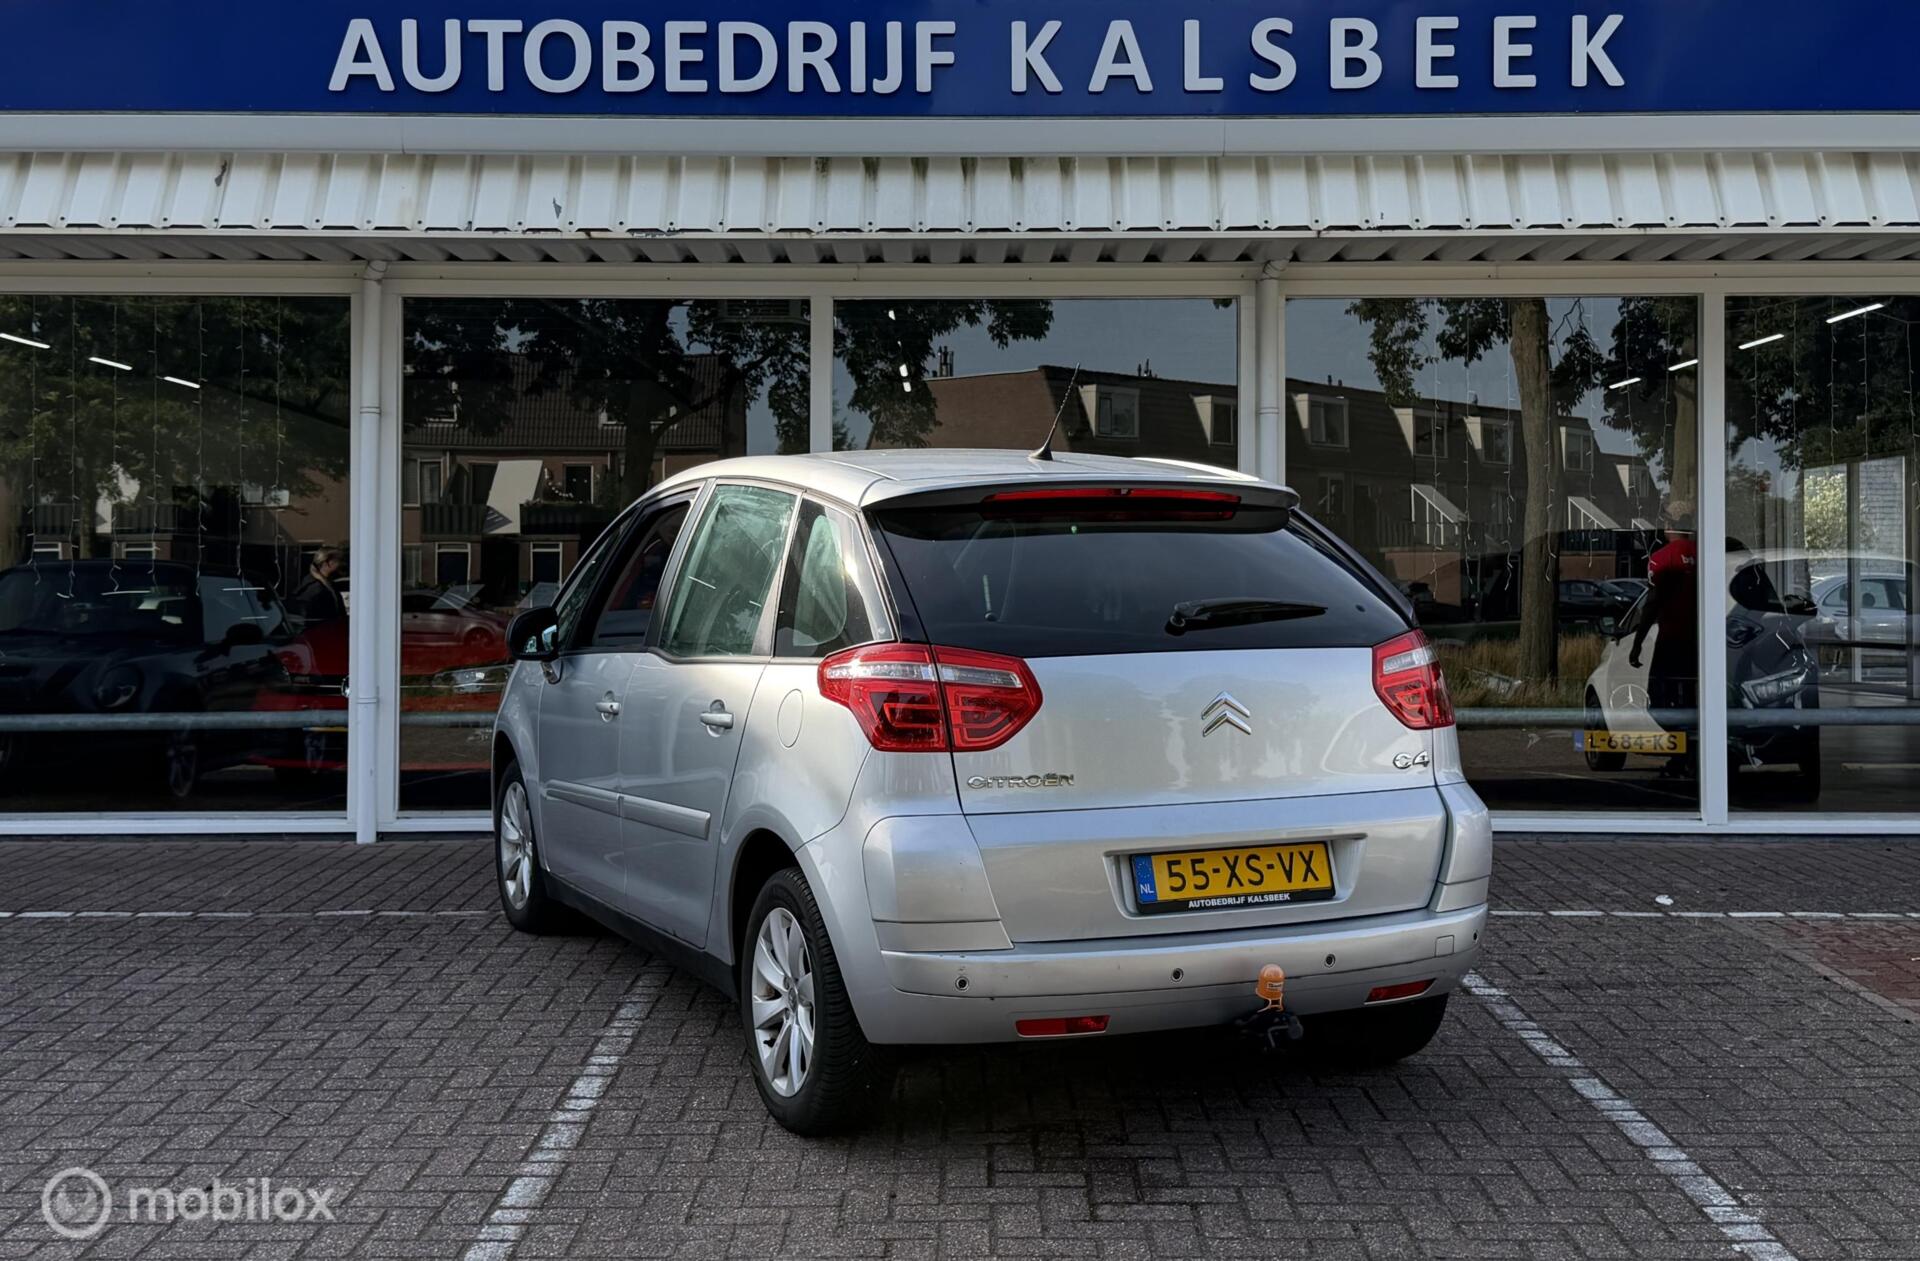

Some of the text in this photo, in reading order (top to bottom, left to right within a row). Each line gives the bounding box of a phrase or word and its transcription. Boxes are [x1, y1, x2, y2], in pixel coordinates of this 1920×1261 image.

[328, 14, 1626, 94] AUTOBEDRIJF KALSBEEK
[1589, 733, 1678, 751] L-684-KS
[1392, 750, 1430, 770] C4
[1166, 850, 1320, 892] 55-XS-VX
[1139, 883, 1155, 894] NL
[1188, 893, 1291, 908] AUTOBEDRIJF KALSBEEK
